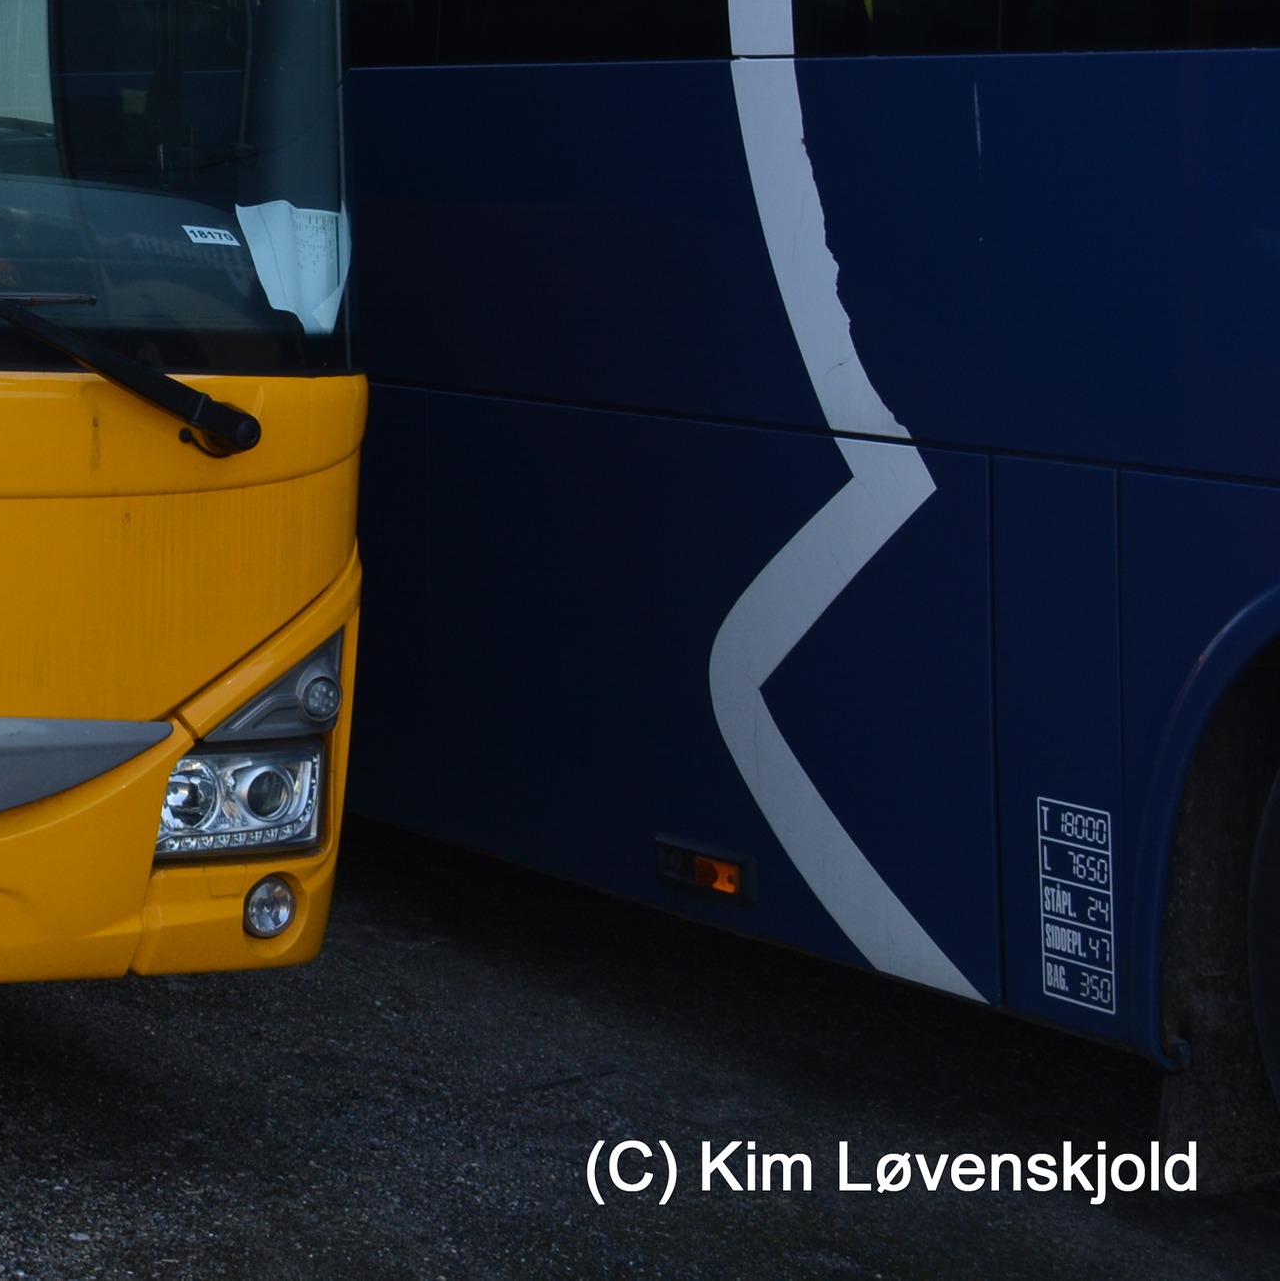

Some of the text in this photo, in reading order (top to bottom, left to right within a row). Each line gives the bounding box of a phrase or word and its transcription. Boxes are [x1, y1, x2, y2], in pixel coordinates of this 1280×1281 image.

[189, 229, 234, 241] 18170
[1042, 806, 1106, 844] T 18000
[1044, 846, 1107, 884] L 7650
[1044, 884, 1108, 922] STÅPL. 24
[1046, 924, 1110, 962] SIDDEPL. 47
[1047, 963, 1110, 1003] BAG. 350
